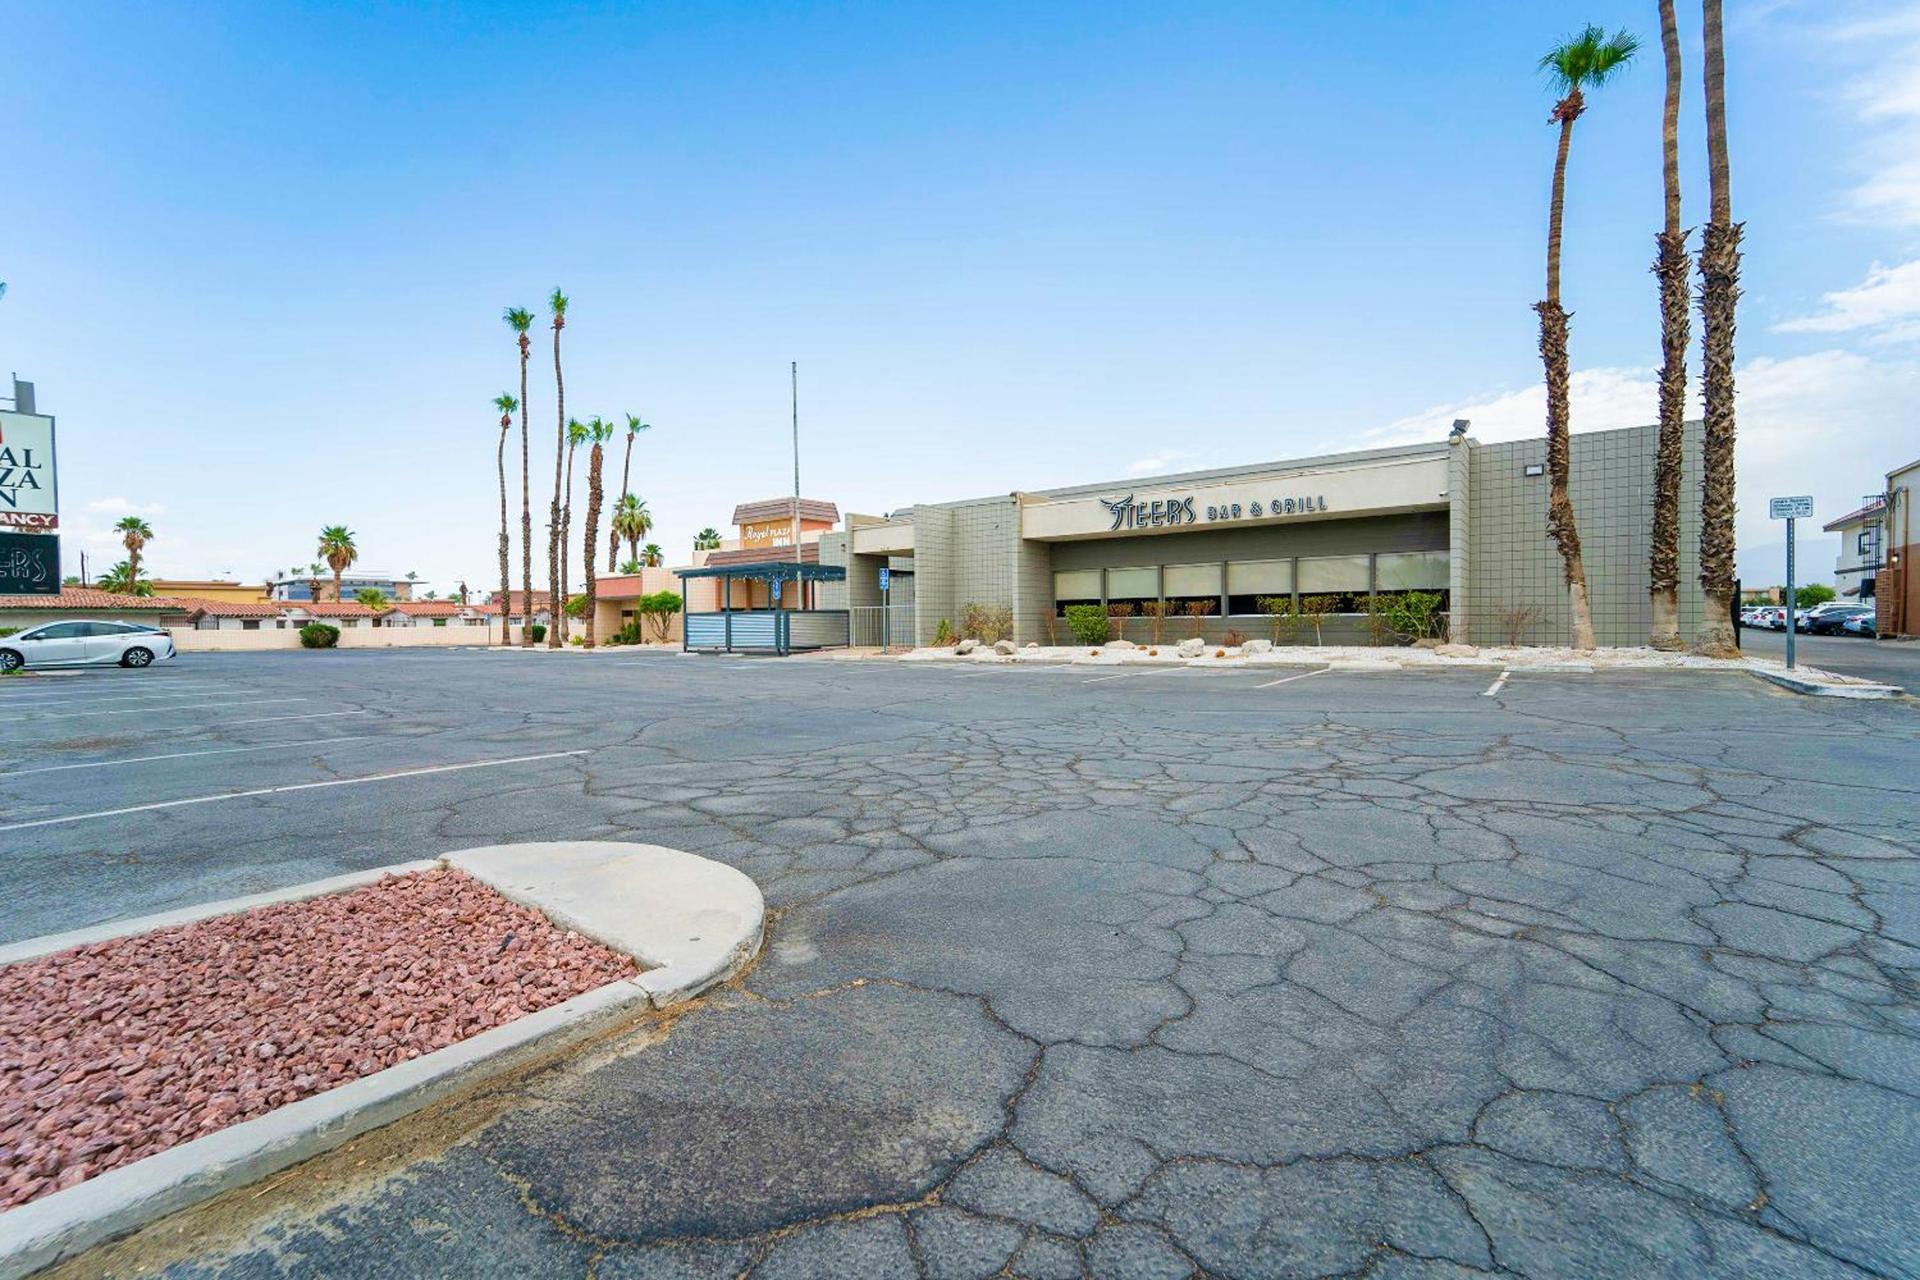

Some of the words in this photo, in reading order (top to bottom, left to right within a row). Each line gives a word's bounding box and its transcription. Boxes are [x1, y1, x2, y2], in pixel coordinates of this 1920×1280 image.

[1099, 493, 1196, 531] STEERS
[1207, 503, 1241, 520] BAR
[1250, 501, 1263, 516] &
[1271, 495, 1328, 514] GRILL
